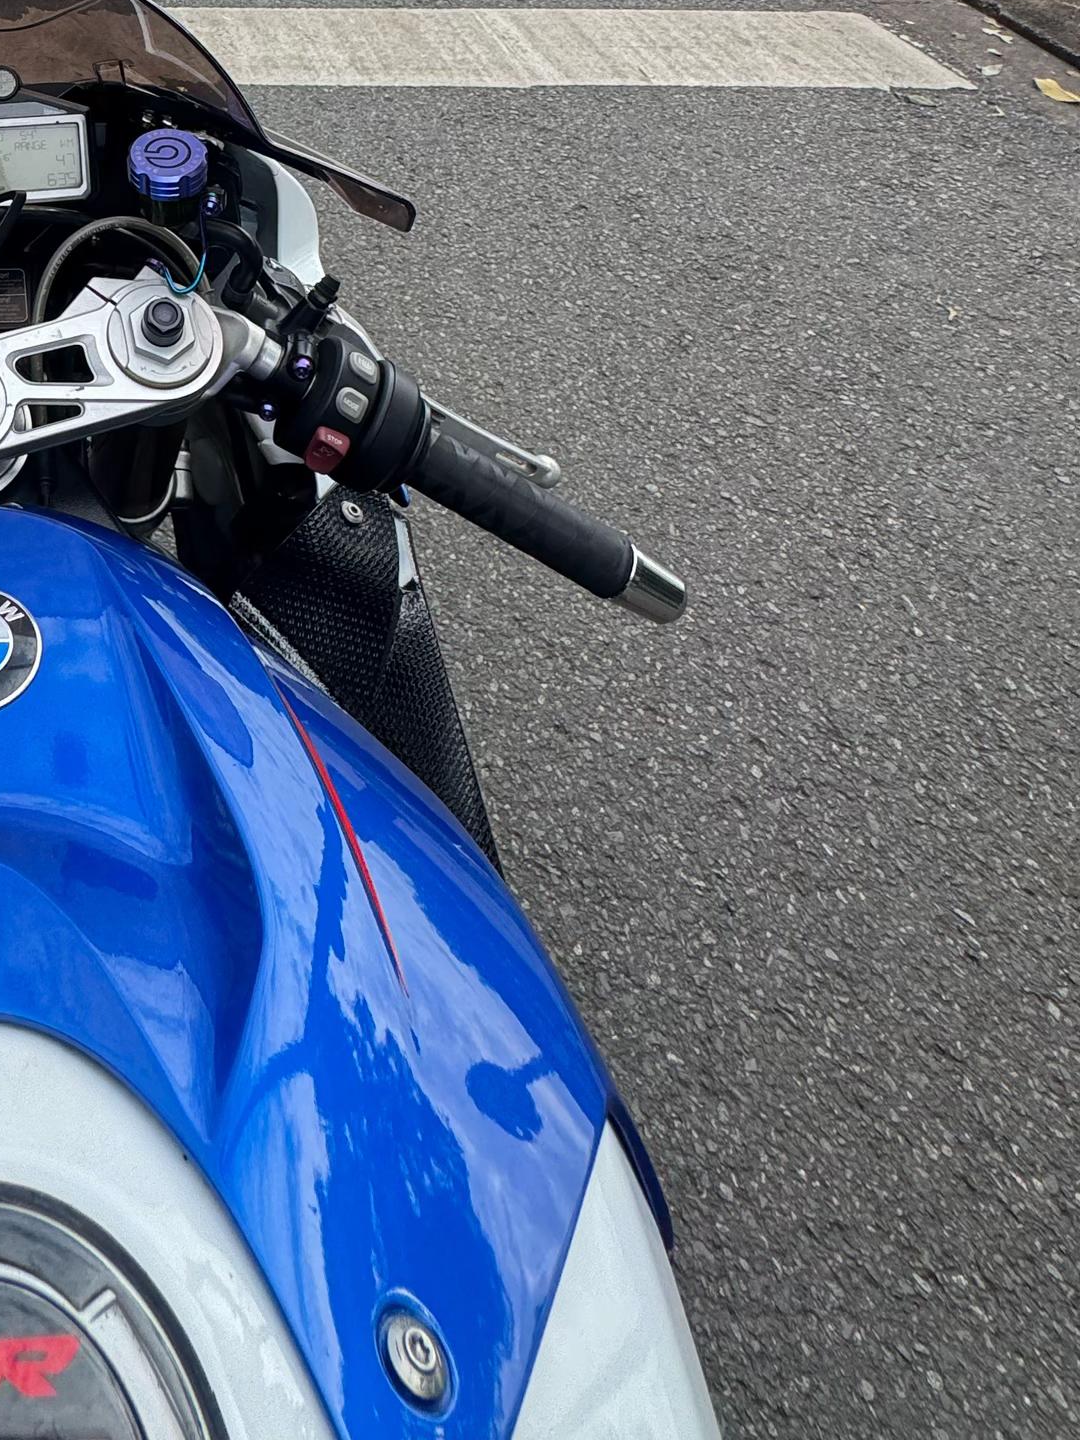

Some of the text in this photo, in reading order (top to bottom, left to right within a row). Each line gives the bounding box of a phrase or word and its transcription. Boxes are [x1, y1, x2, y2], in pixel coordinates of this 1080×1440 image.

[14, 140, 48, 152] RANGE
[47, 172, 78, 187] 635
[326, 433, 343, 447] STOP
